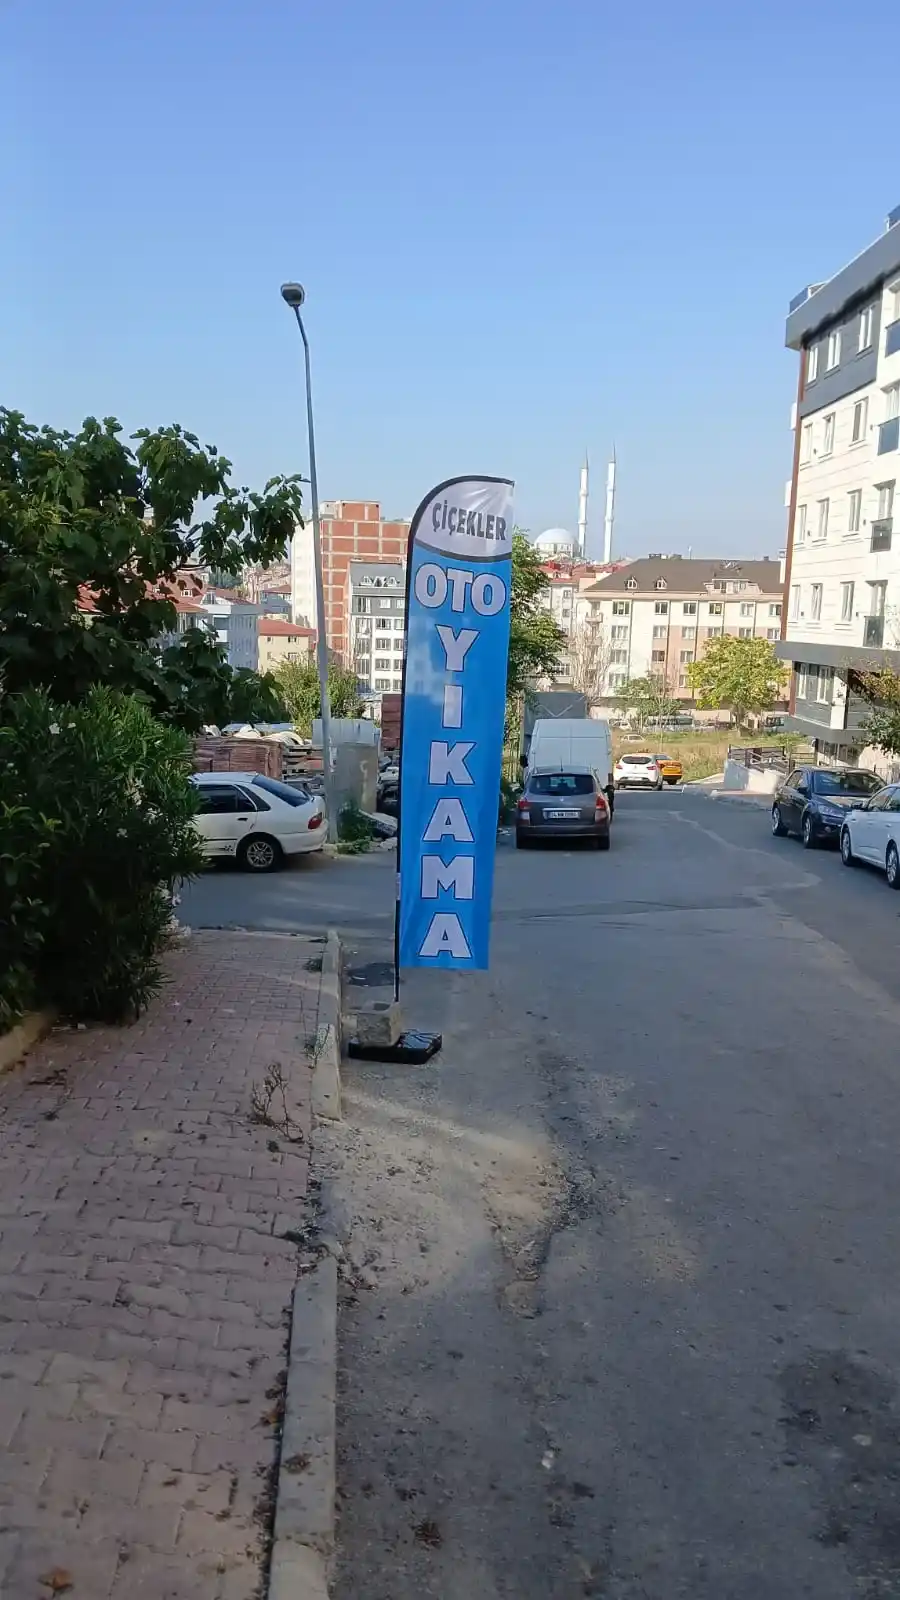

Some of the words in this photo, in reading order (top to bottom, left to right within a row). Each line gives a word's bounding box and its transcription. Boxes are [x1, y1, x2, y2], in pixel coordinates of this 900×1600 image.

[433, 500, 506, 540] ÇİÇEKLER
[415, 563, 506, 616] OTO
[419, 625, 480, 958] YIKAMA
